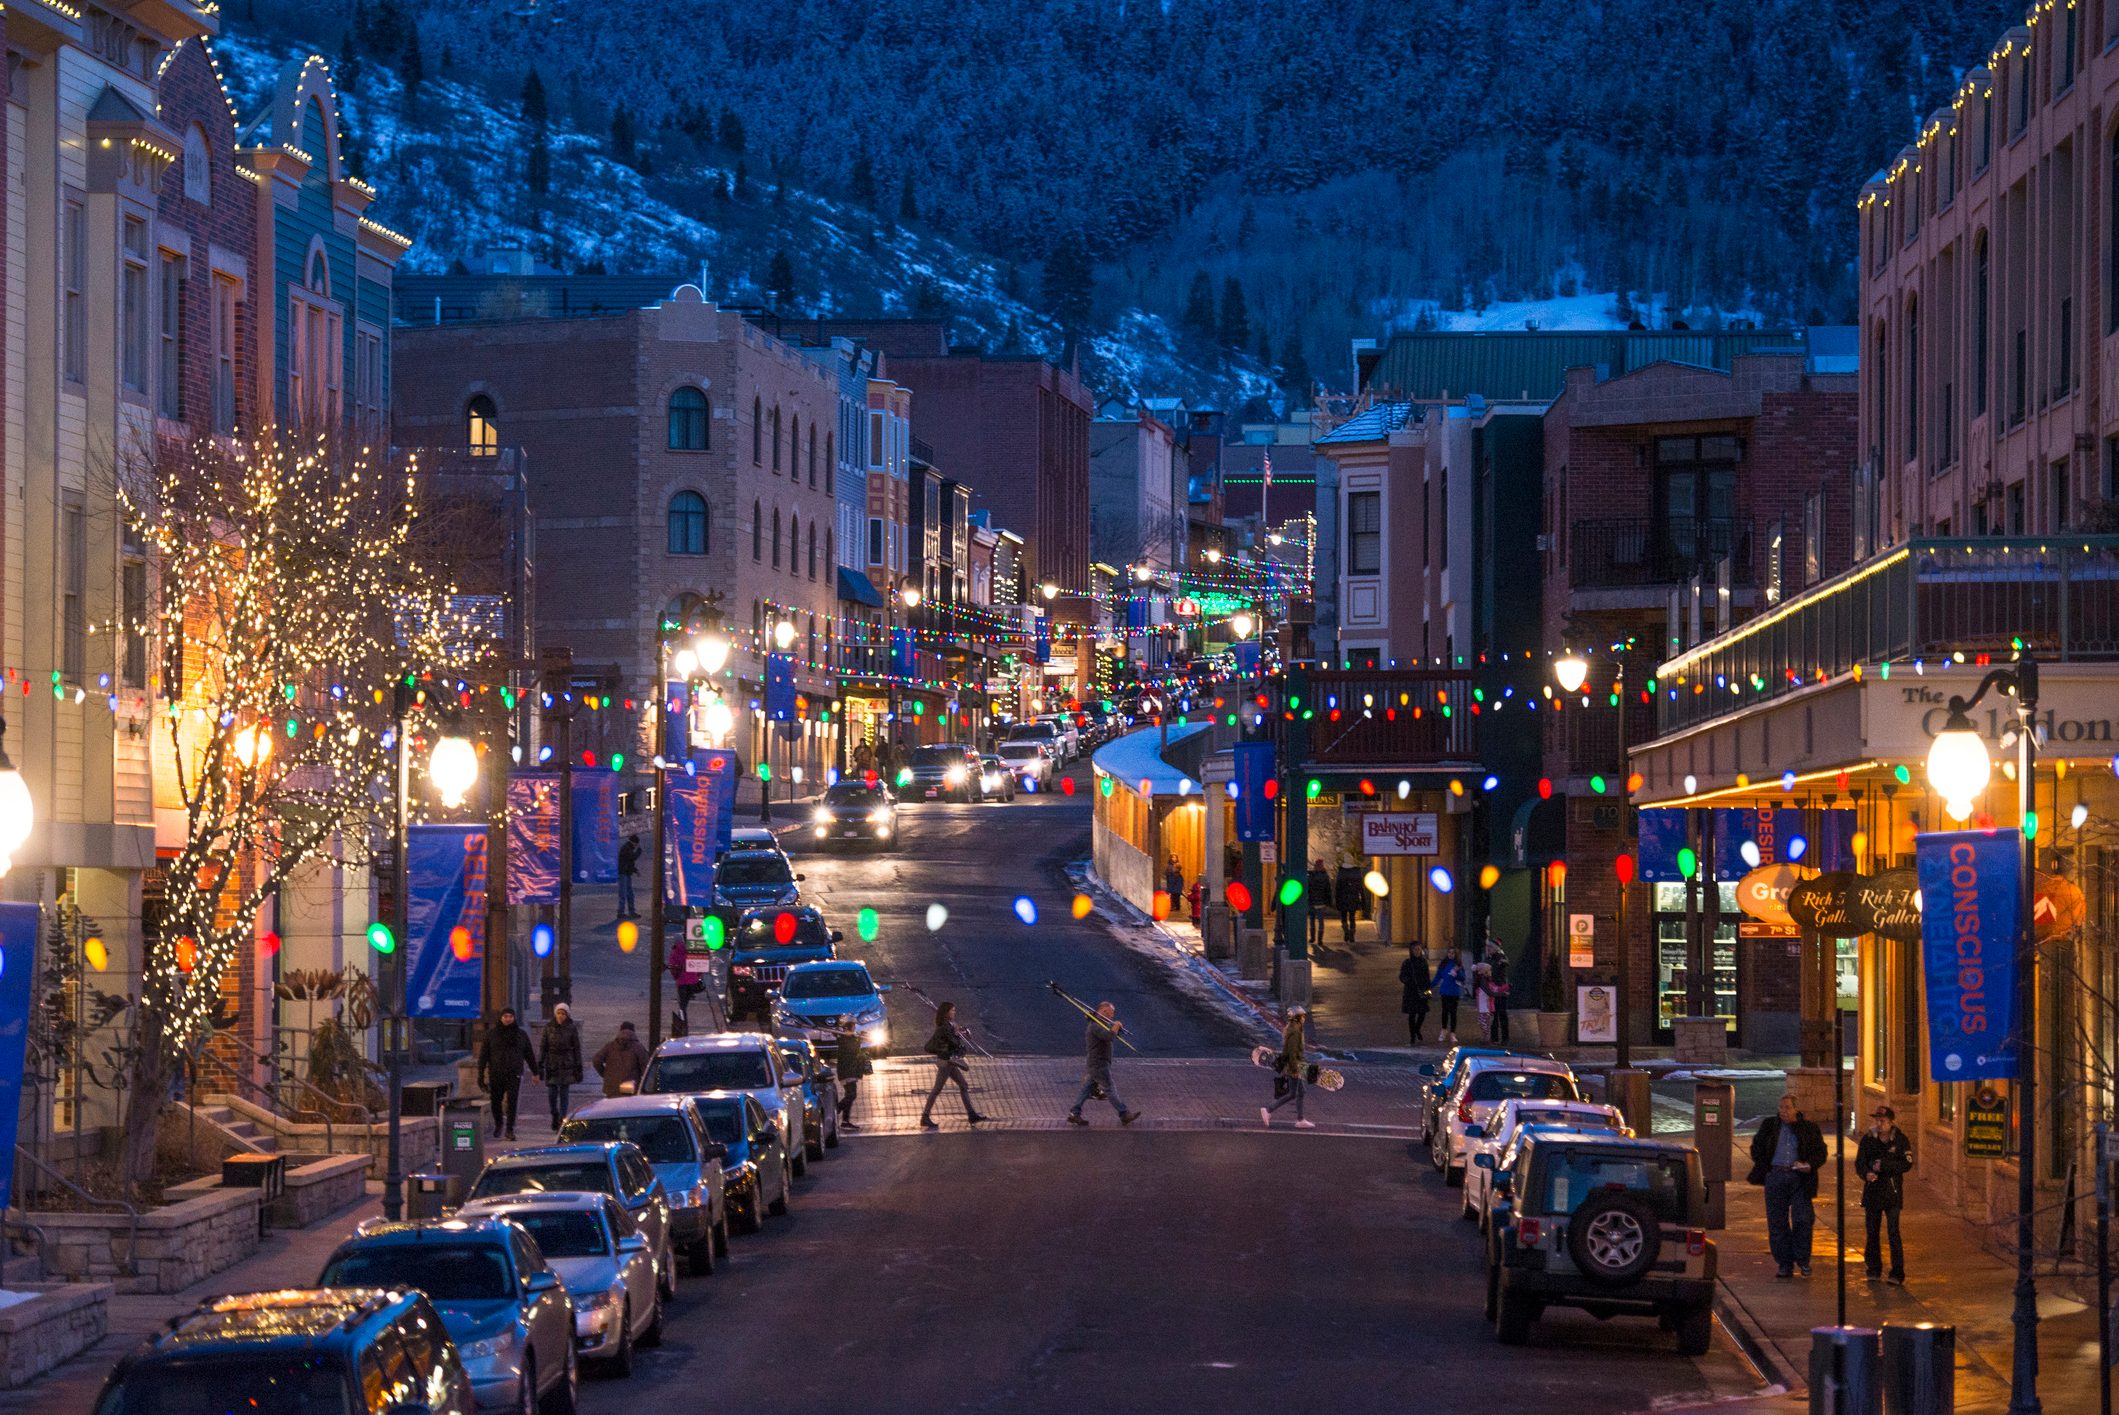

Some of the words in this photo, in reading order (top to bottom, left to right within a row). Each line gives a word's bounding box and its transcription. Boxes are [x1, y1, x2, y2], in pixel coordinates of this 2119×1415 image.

[1902, 686, 1944, 704] The
[1802, 892, 1832, 911] Rich
[1859, 889, 1893, 914] Rich
[1785, 926, 1797, 935] St
[1950, 842, 1987, 1035] CONSCIOUS
[1968, 1111, 2005, 1122] FREE
